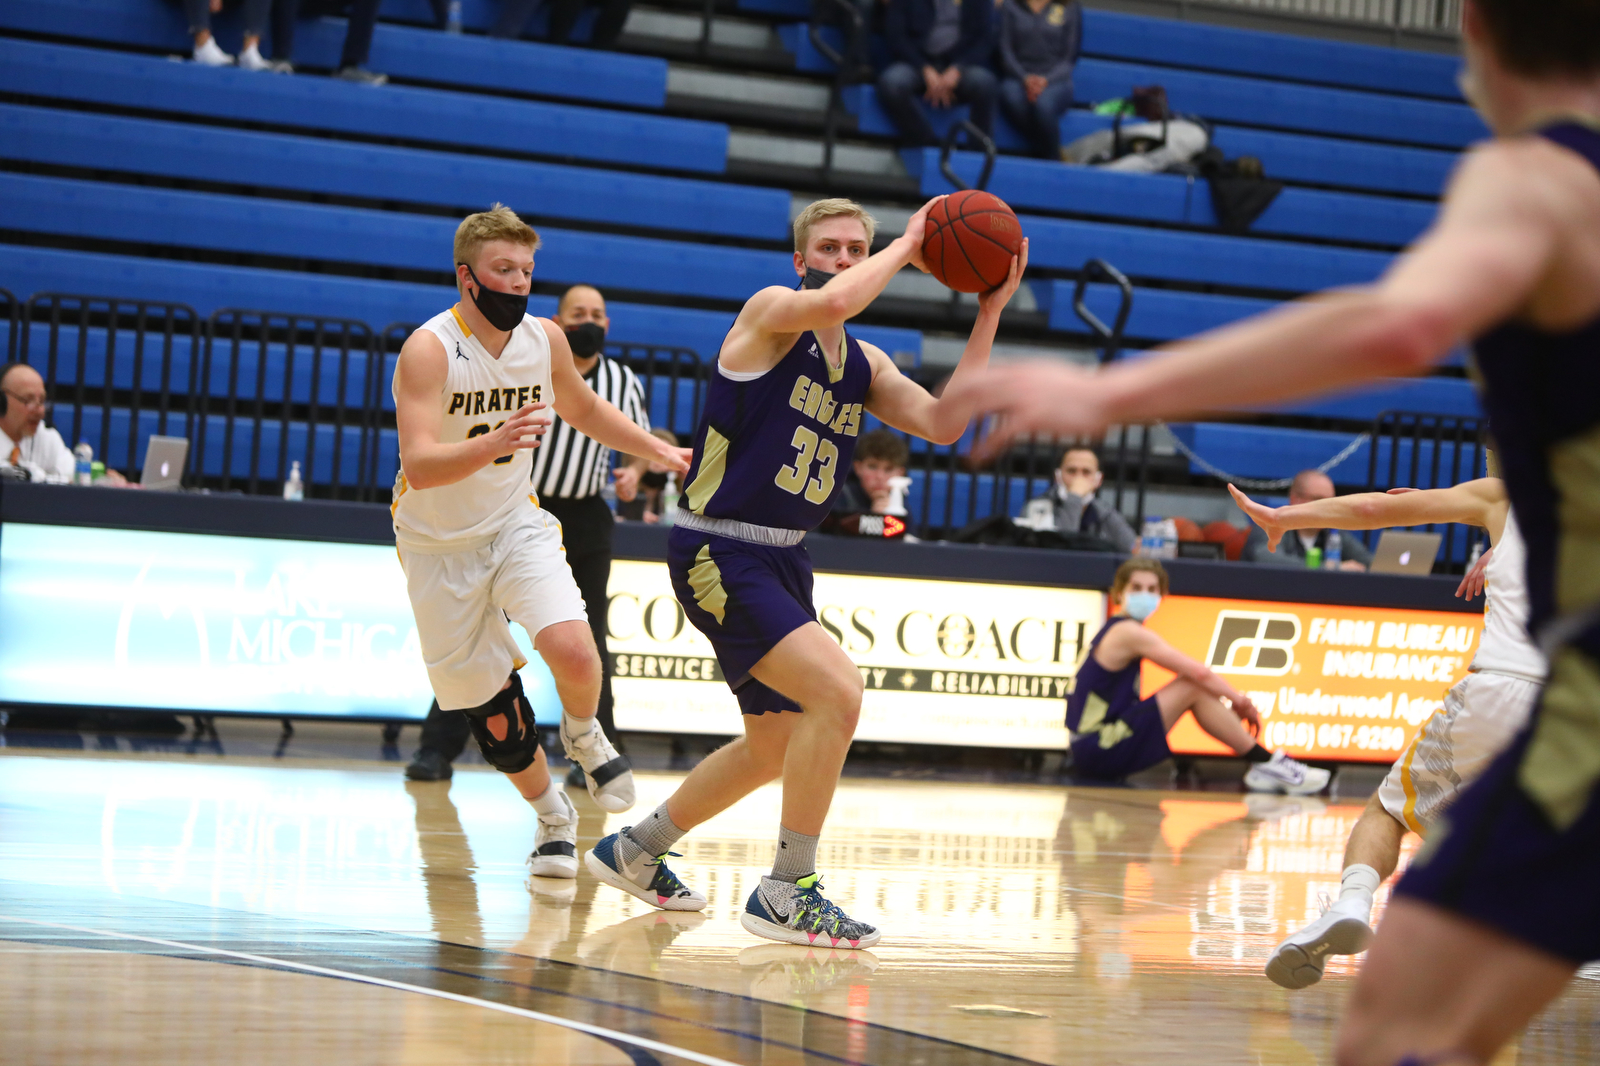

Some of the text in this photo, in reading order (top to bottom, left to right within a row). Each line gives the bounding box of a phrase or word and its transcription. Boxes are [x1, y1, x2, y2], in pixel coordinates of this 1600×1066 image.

[448, 385, 542, 416] PIRATES
[789, 374, 863, 437] EAGLES
[775, 425, 839, 505] 33
[227, 617, 423, 665] MICHIGA
[897, 610, 1087, 664] COACH
[1308, 617, 1474, 653] FARM BUREAU
[615, 654, 1069, 697] SERVICE RELIABILITY
[1322, 650, 1457, 683] INSURANCE
[1278, 686, 1393, 719] Underwood
[1264, 721, 1316, 752] (616)
